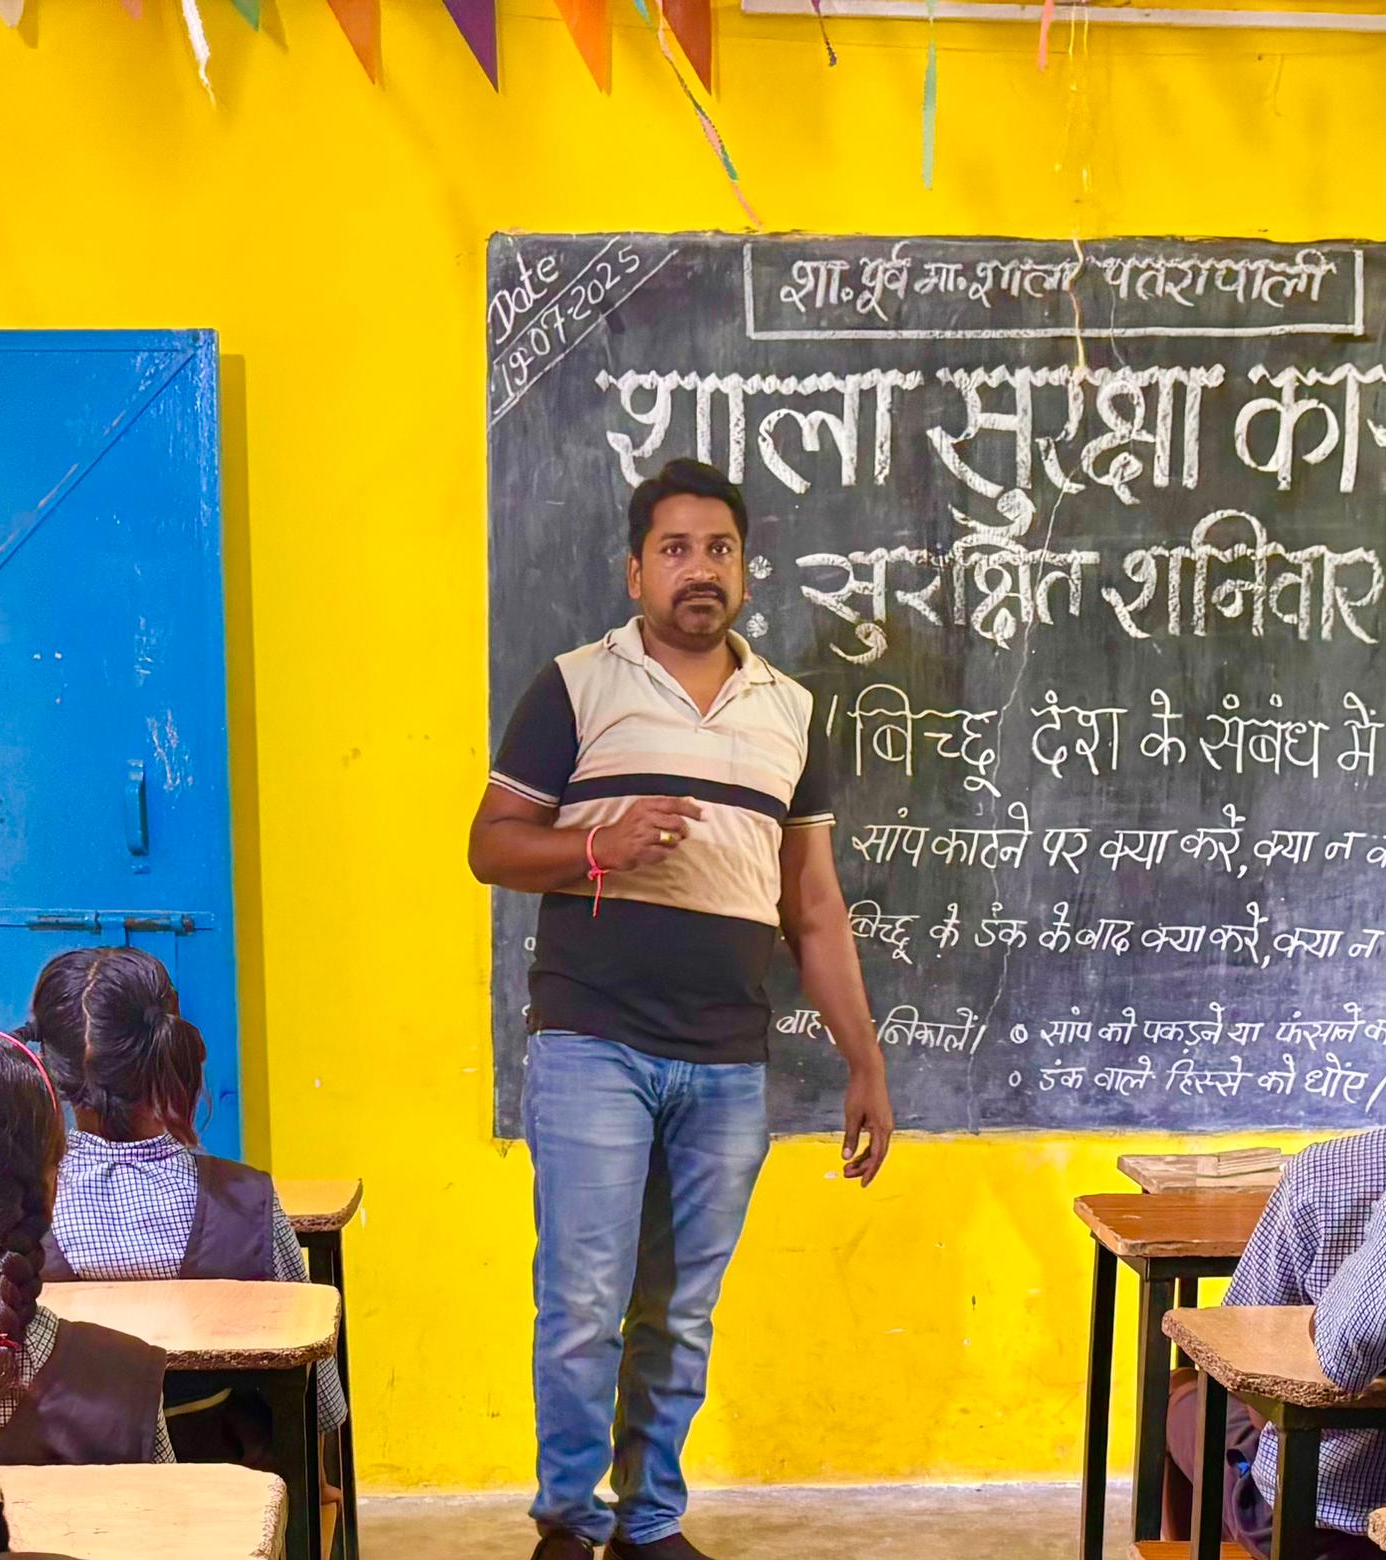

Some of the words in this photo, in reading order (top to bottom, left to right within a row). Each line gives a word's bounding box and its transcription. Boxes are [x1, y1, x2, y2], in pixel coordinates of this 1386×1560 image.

[487, 252, 560, 345] Date
[856, 240, 913, 322] पूर्व
[595, 367, 923, 496] शाला
[925, 364, 1226, 537] सुरक्षा
[1139, 688, 1187, 767] के
[1199, 692, 1331, 779] संबंध
[1336, 691, 1385, 778] में
[851, 806, 931, 868] सांप
[931, 800, 1034, 870] काटने
[1042, 827, 1093, 875] पर
[1099, 829, 1179, 872] क्या
[1253, 829, 1321, 867] क्या
[1324, 831, 1368, 861] न
[928, 902, 961, 949] के
[1038, 901, 1072, 953] के
[1074, 918, 1136, 957] बाद
[1140, 924, 1207, 953] क्या
[1272, 926, 1346, 959] क्या
[1347, 928, 1386, 959] न
[1039, 1004, 1094, 1047] सांप
[1097, 1005, 1139, 1045] को
[1227, 1021, 1266, 1046] या
[1275, 1000, 1367, 1051] फंसाने
[1039, 1057, 1088, 1092] डंक
[1093, 1054, 1155, 1096] वाले
[1164, 1054, 1255, 1097] हिस्से
[1257, 1052, 1298, 1096] को
